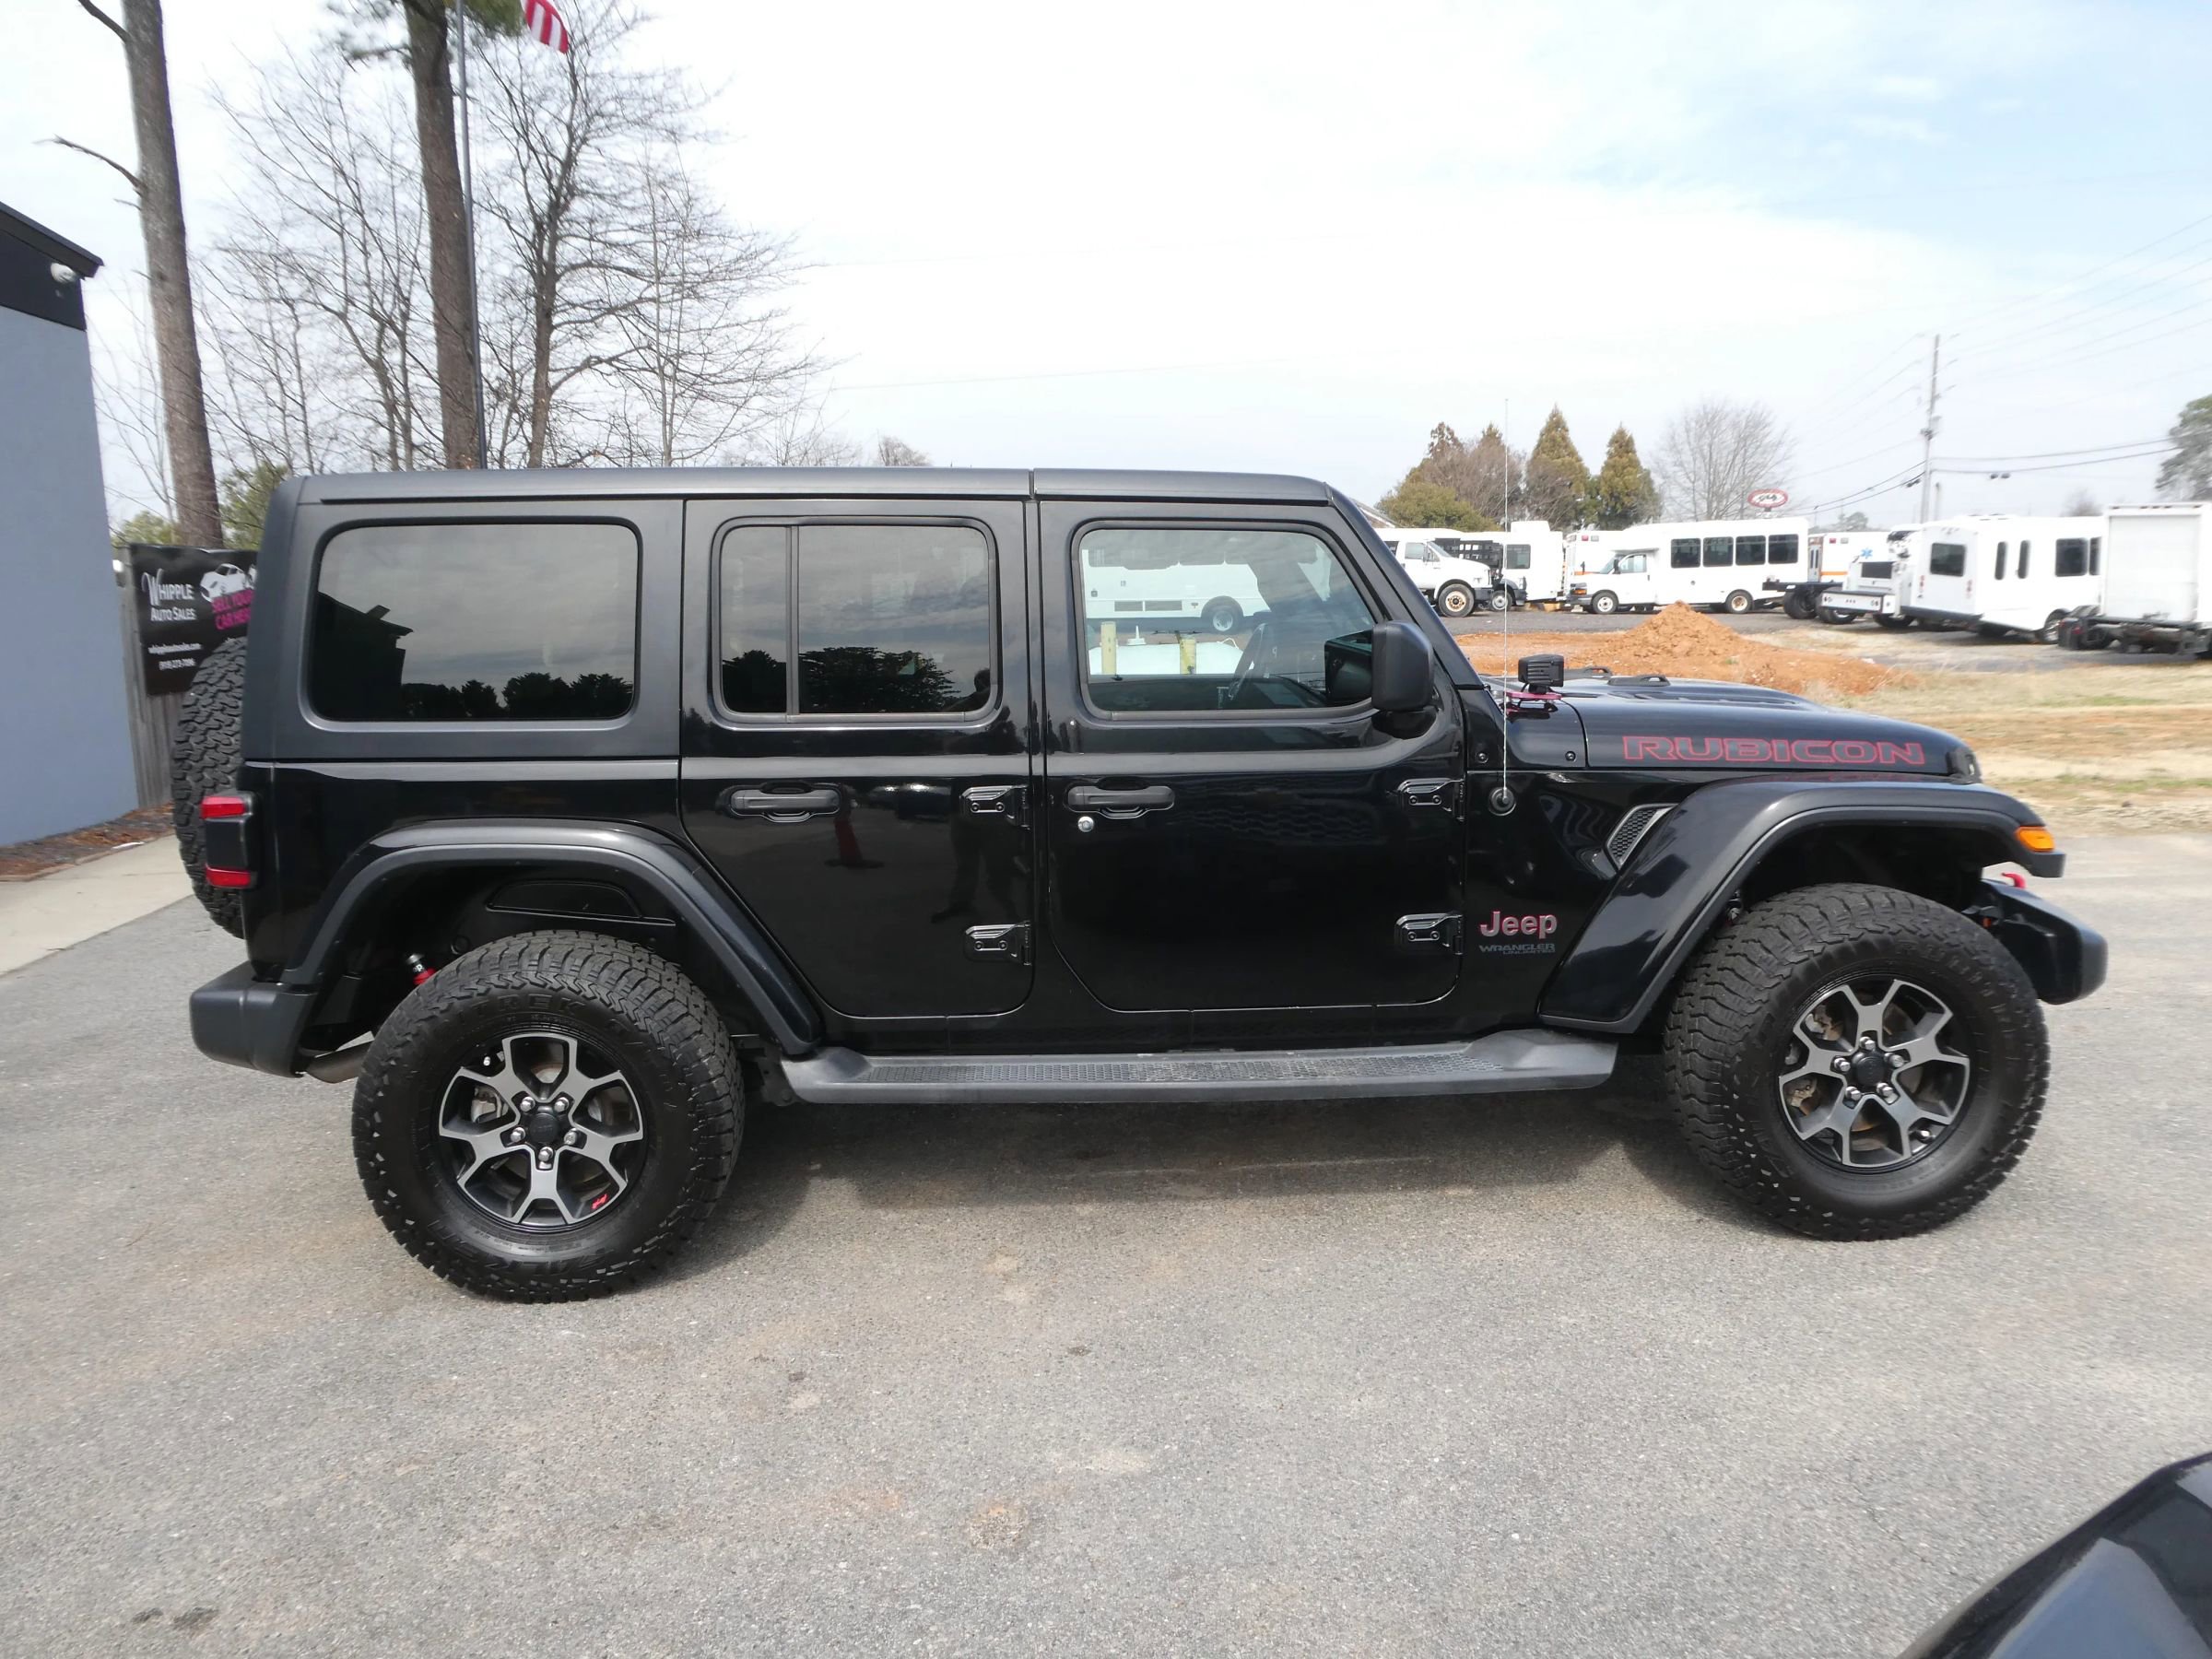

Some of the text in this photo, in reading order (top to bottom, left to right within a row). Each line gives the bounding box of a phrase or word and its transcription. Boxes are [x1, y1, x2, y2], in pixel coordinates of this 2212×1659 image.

[141, 568, 194, 606] WHIPPLE
[150, 606, 196, 621] AUTO SALES
[1622, 735, 1925, 764] RUBICON
[1479, 911, 1558, 939] Jeep
[1478, 943, 1556, 953] WRANGLER
